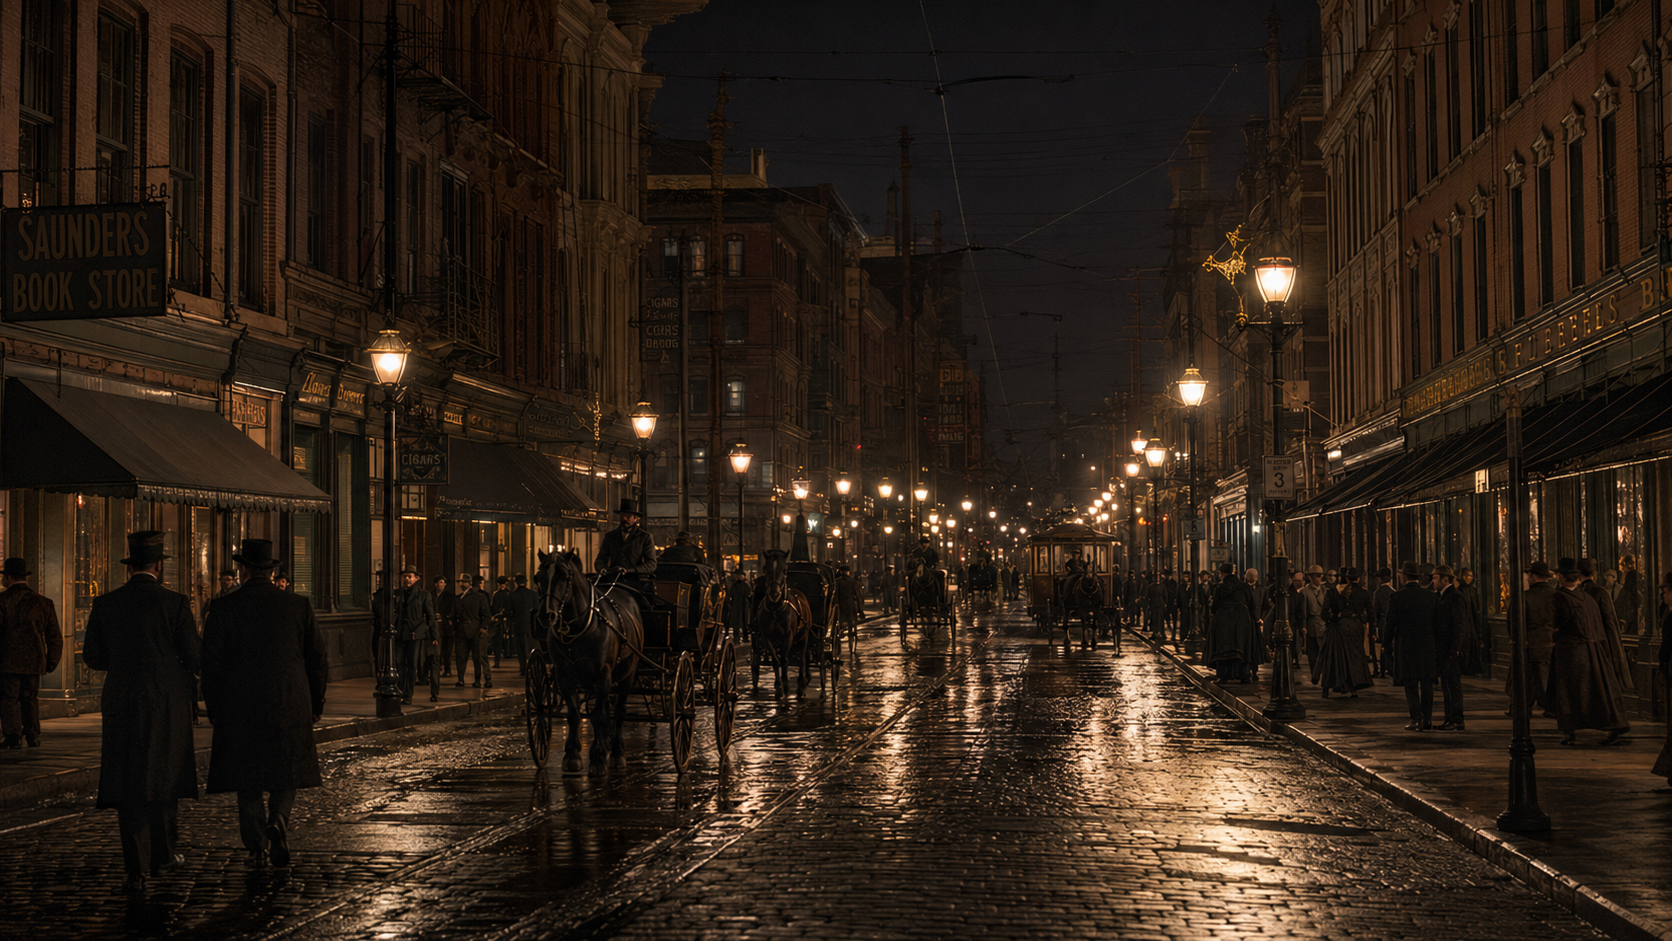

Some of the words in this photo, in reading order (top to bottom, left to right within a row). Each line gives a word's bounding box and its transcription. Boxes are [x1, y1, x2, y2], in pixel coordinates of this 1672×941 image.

[18, 210, 150, 261] SAUNDERS
[13, 271, 75, 313] BOOK
[88, 268, 159, 310] STORE
[401, 453, 441, 465] CIGARS
[1274, 472, 1285, 488] 3
